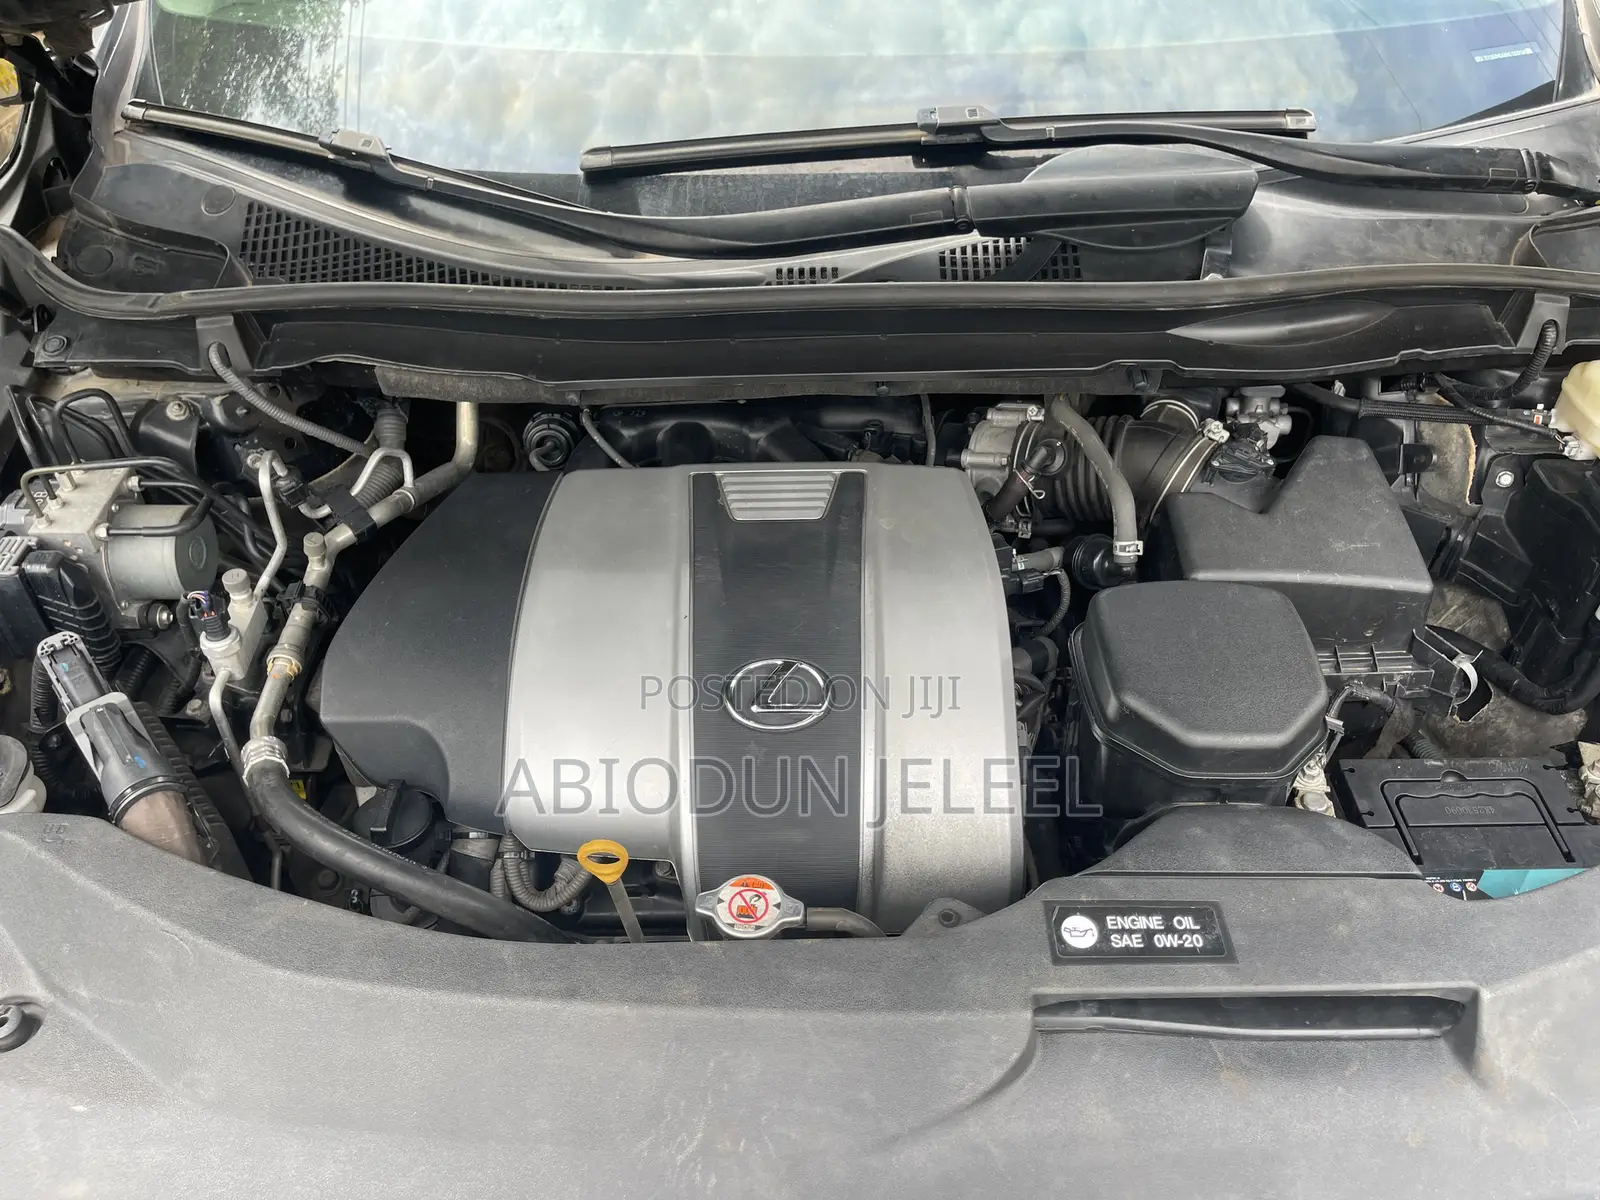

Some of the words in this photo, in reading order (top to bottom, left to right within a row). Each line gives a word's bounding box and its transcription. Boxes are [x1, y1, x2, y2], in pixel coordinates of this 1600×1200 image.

[1105, 915, 1164, 930] ENGINE
[1172, 915, 1201, 930] OIL
[1110, 933, 1144, 948] SAE
[1153, 933, 1204, 948] 0W-20
